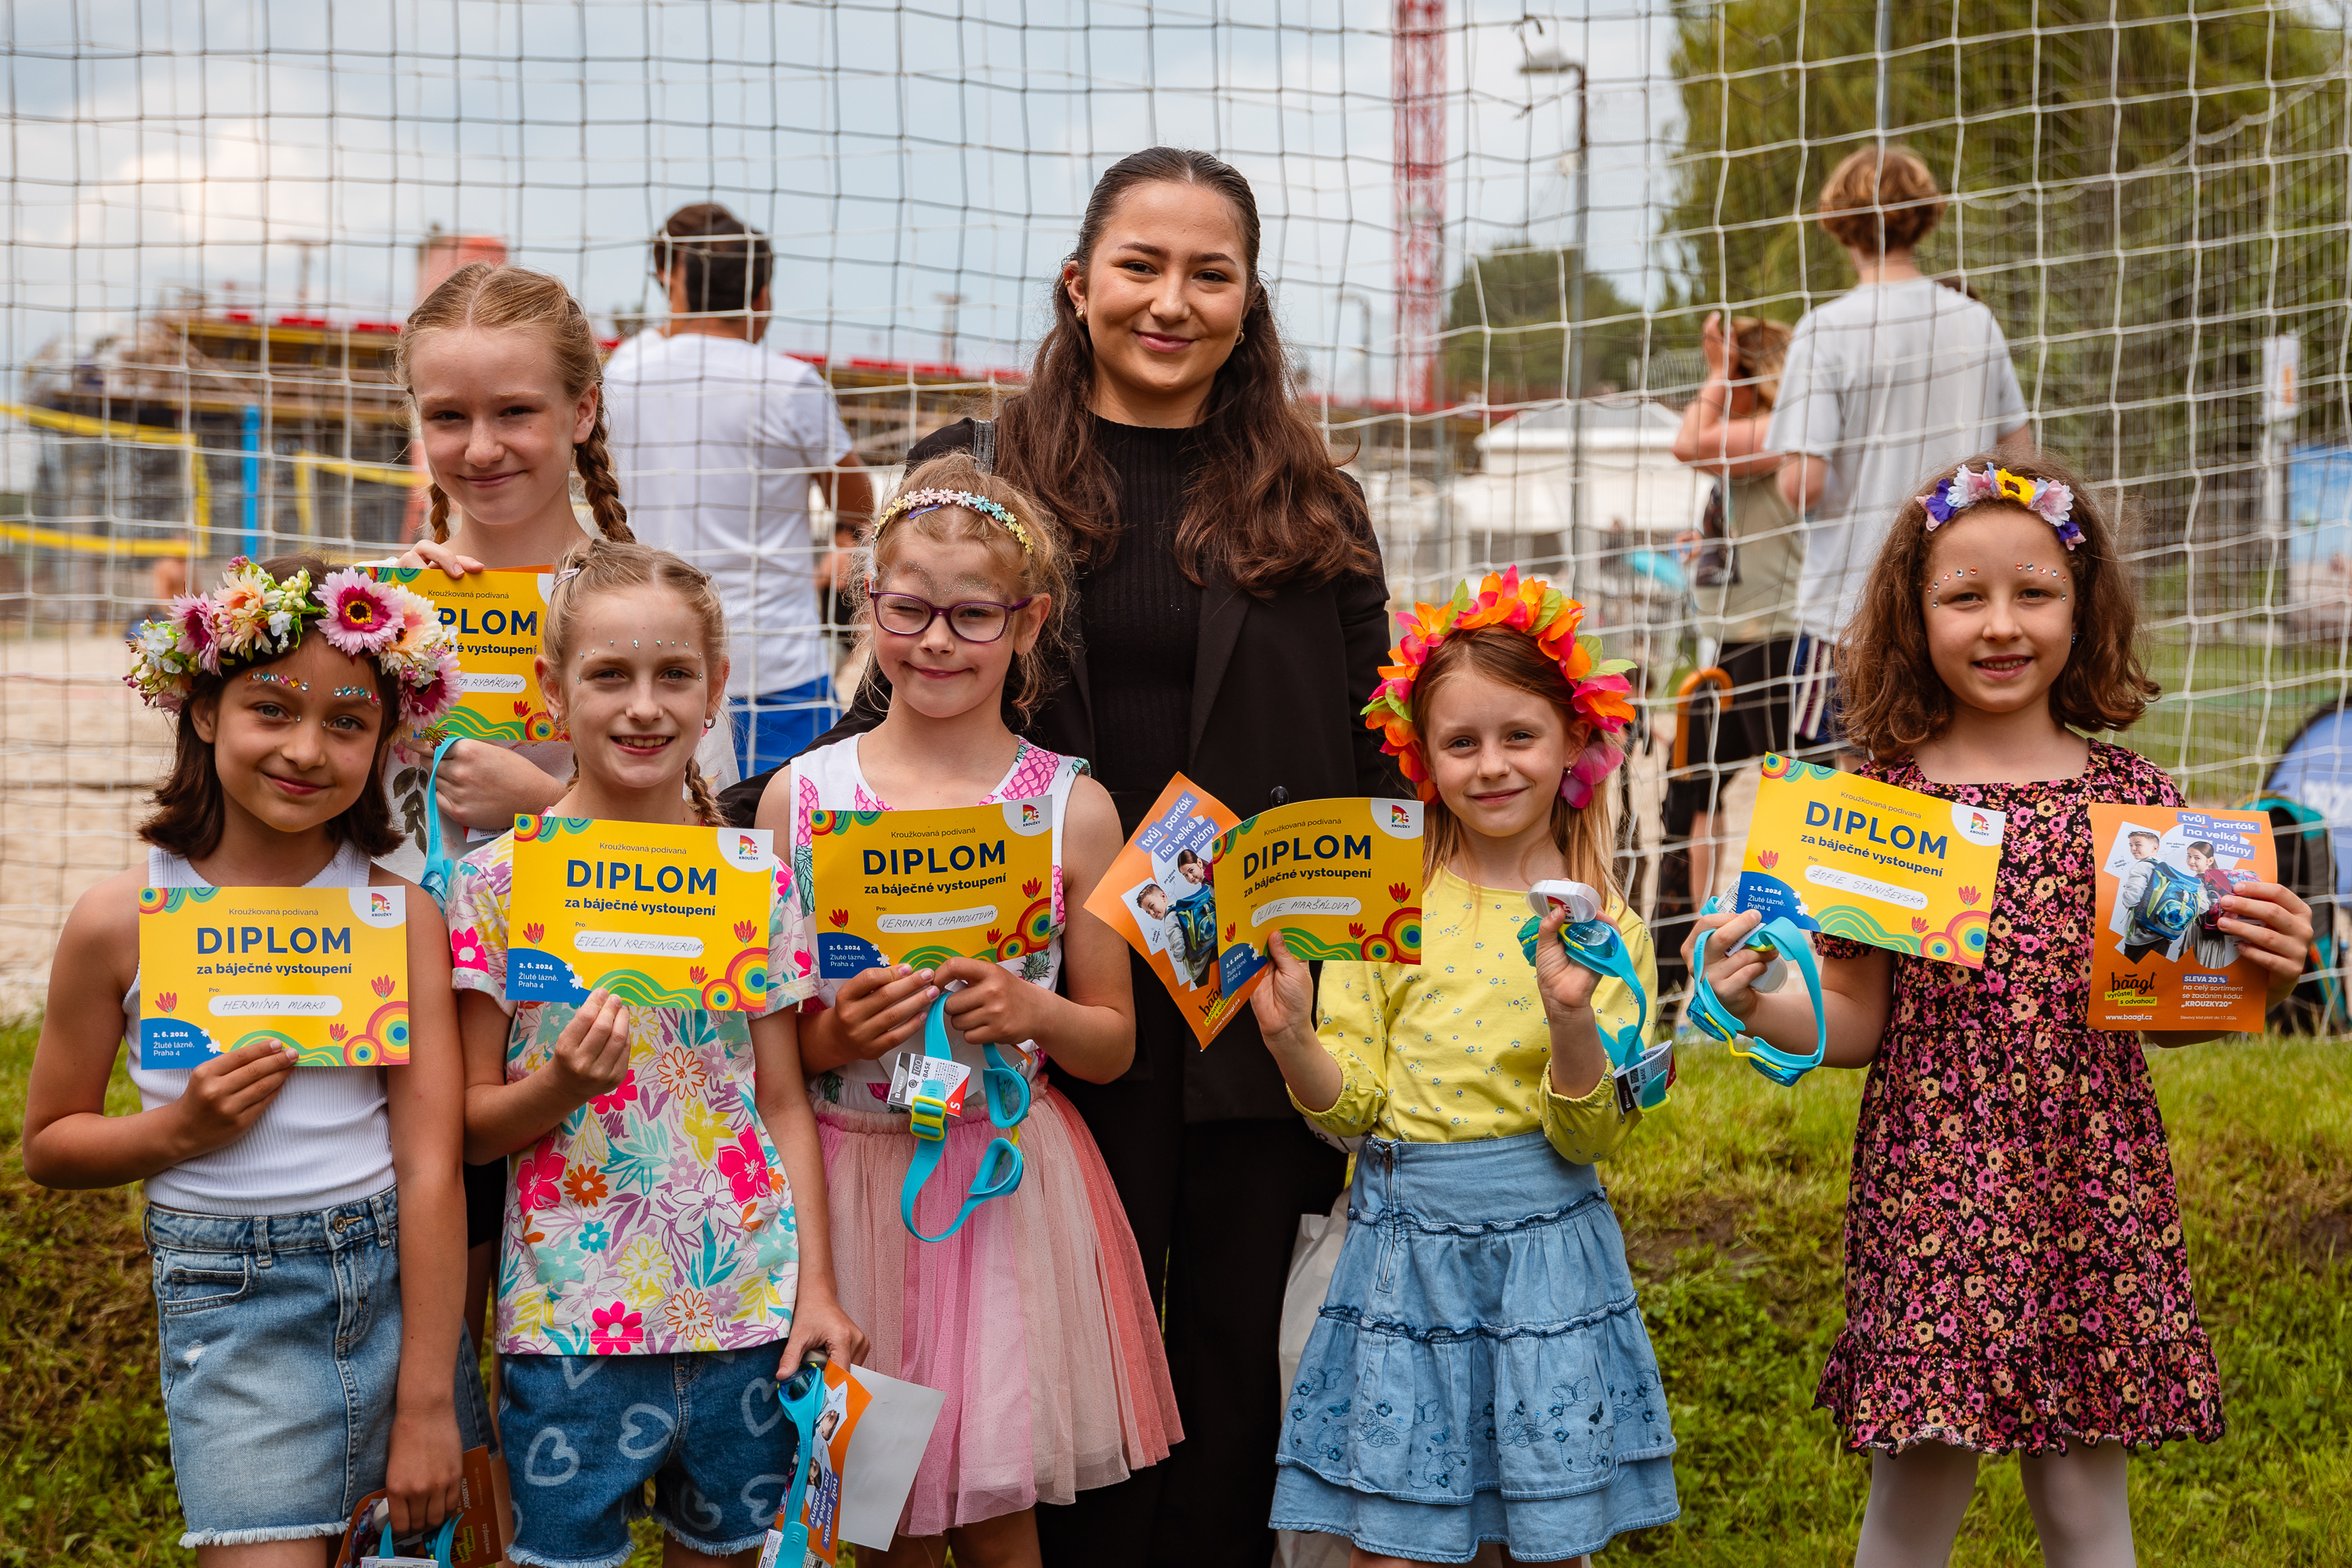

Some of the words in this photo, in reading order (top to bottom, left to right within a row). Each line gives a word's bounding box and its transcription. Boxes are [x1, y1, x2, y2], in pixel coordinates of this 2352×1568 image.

[428, 590, 474, 599] Kroužkovaná
[475, 591, 510, 600] podívaná
[437, 607, 538, 637] PLOM
[467, 644, 538, 656] vystoupení
[1840, 791, 1886, 810] Kroužkovaná
[1888, 804, 1922, 819] podívaná
[1025, 810, 1040, 822] 25
[1142, 826, 1163, 847] tvůj
[1164, 797, 1193, 831] parťák
[1394, 812, 1410, 824] 25
[2182, 814, 2205, 824] tvůj
[2213, 822, 2256, 831] parťák
[891, 829, 940, 839] Kroužkovaná
[941, 826, 976, 837] podívaná
[1264, 820, 1305, 837] Kroužkovaná
[1306, 818, 1341, 829] podívaná
[1805, 800, 1948, 860] DIPLOM
[1973, 819, 1990, 832] 25
[1160, 843, 1174, 858] na
[1172, 819, 1196, 844] velké
[1189, 822, 1215, 851] plány
[2186, 828, 2202, 837] na
[2205, 831, 2238, 841] velké
[599, 842, 649, 854] Kroužkovaná
[651, 846, 688, 855] podívaná
[742, 843, 758, 855] 25
[1800, 833, 1816, 844] za
[1818, 836, 1871, 858] báječné
[1872, 851, 1944, 878] vystoupení
[2216, 843, 2252, 857] plány
[862, 840, 1006, 876] DIPLOM
[1243, 835, 1372, 881] DIPLOM
[566, 859, 717, 896] DIPLOM
[1243, 887, 1254, 898] za
[1254, 868, 1298, 891] báječné
[1299, 868, 1372, 880] vystoupení
[881, 883, 935, 897] báječné
[937, 873, 1007, 894] vystoupení
[1764, 887, 1782, 896] 2024
[1748, 894, 1766, 903] Žluté
[229, 908, 281, 916] Kroužkovaná
[282, 908, 319, 916] podívaná
[374, 900, 391, 912] 25
[564, 899, 580, 909] za
[583, 897, 638, 913] báječné
[641, 903, 717, 916] vystoupení
[881, 918, 932, 928] VERONIKA
[197, 927, 351, 955] DIPLOM
[576, 936, 622, 947] EVELIN
[196, 965, 212, 975] za
[216, 963, 273, 977] báječné
[275, 963, 353, 977] vystoupení
[518, 971, 536, 981] Žluté
[2107, 989, 2132, 999] vyrůstej
[223, 998, 280, 1011] HERMÍNA
[2105, 1013, 2153, 1022] www.baagl.cz
[913, 1059, 922, 1074] 100
[949, 1101, 961, 1111] S
[824, 1472, 829, 1488] na
[810, 1490, 820, 1525] plány
[818, 1490, 827, 1520] velké
[823, 1502, 833, 1544] parťák
